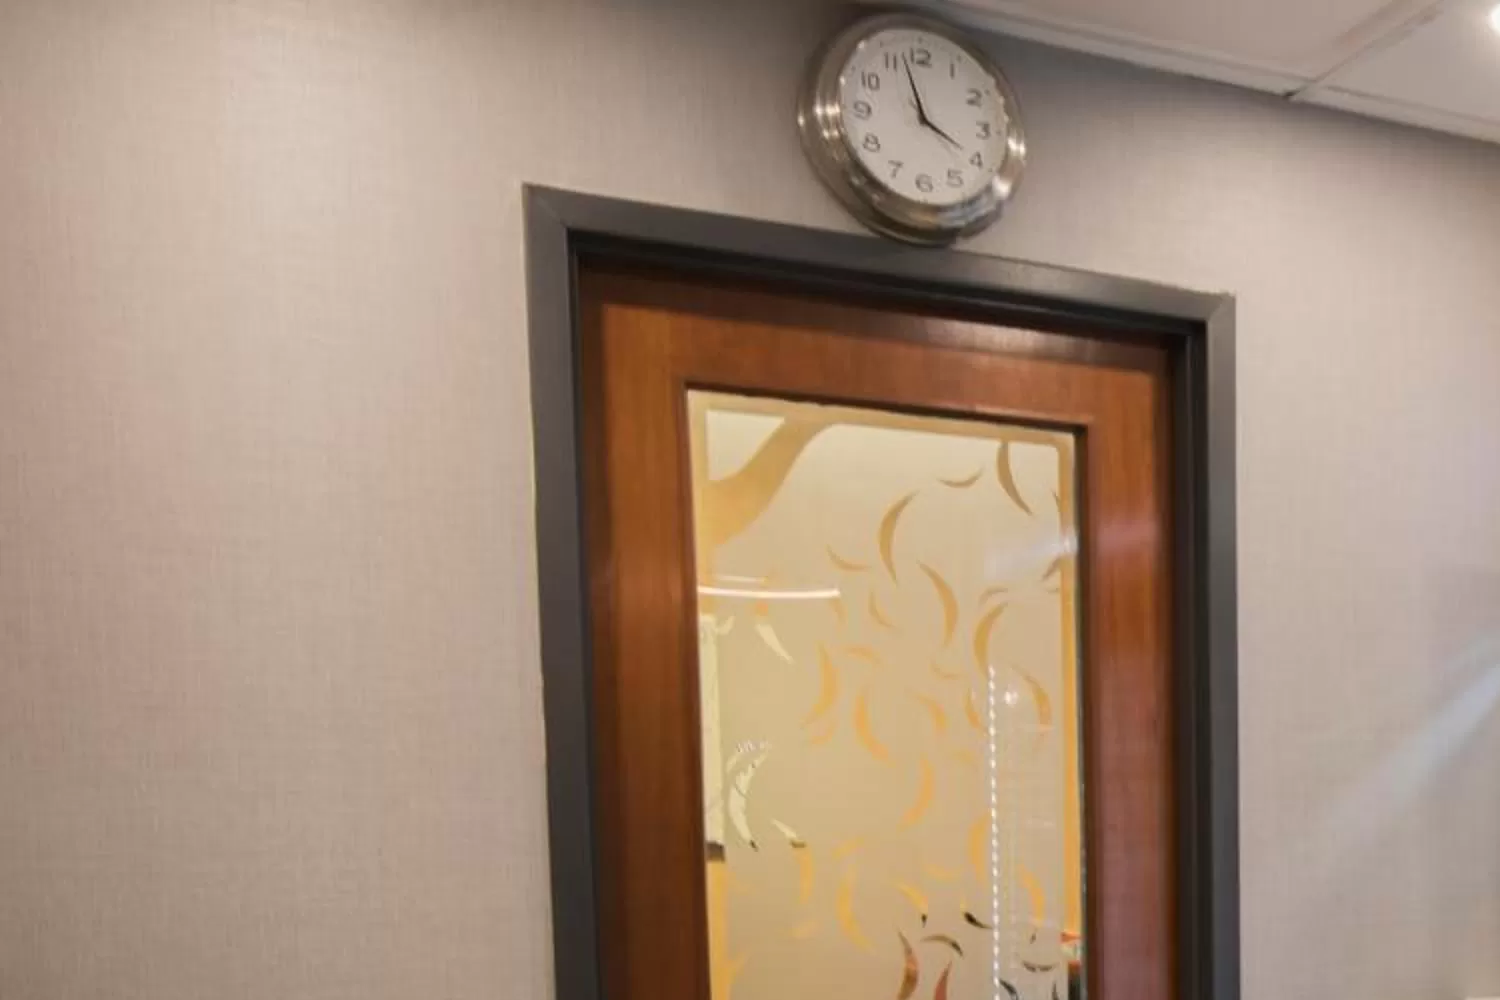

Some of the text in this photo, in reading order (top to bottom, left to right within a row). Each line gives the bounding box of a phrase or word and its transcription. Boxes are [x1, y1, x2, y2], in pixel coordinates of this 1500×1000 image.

[884, 52, 897, 71] 11
[910, 48, 932, 68] 12
[861, 71, 880, 91] 10
[966, 88, 982, 107] 2
[853, 101, 872, 120] 9
[976, 121, 991, 140] 3
[863, 134, 880, 152] 8
[888, 160, 903, 178] 7
[970, 152, 983, 169] 4
[915, 174, 933, 193] 6
[947, 168, 963, 188] 5
